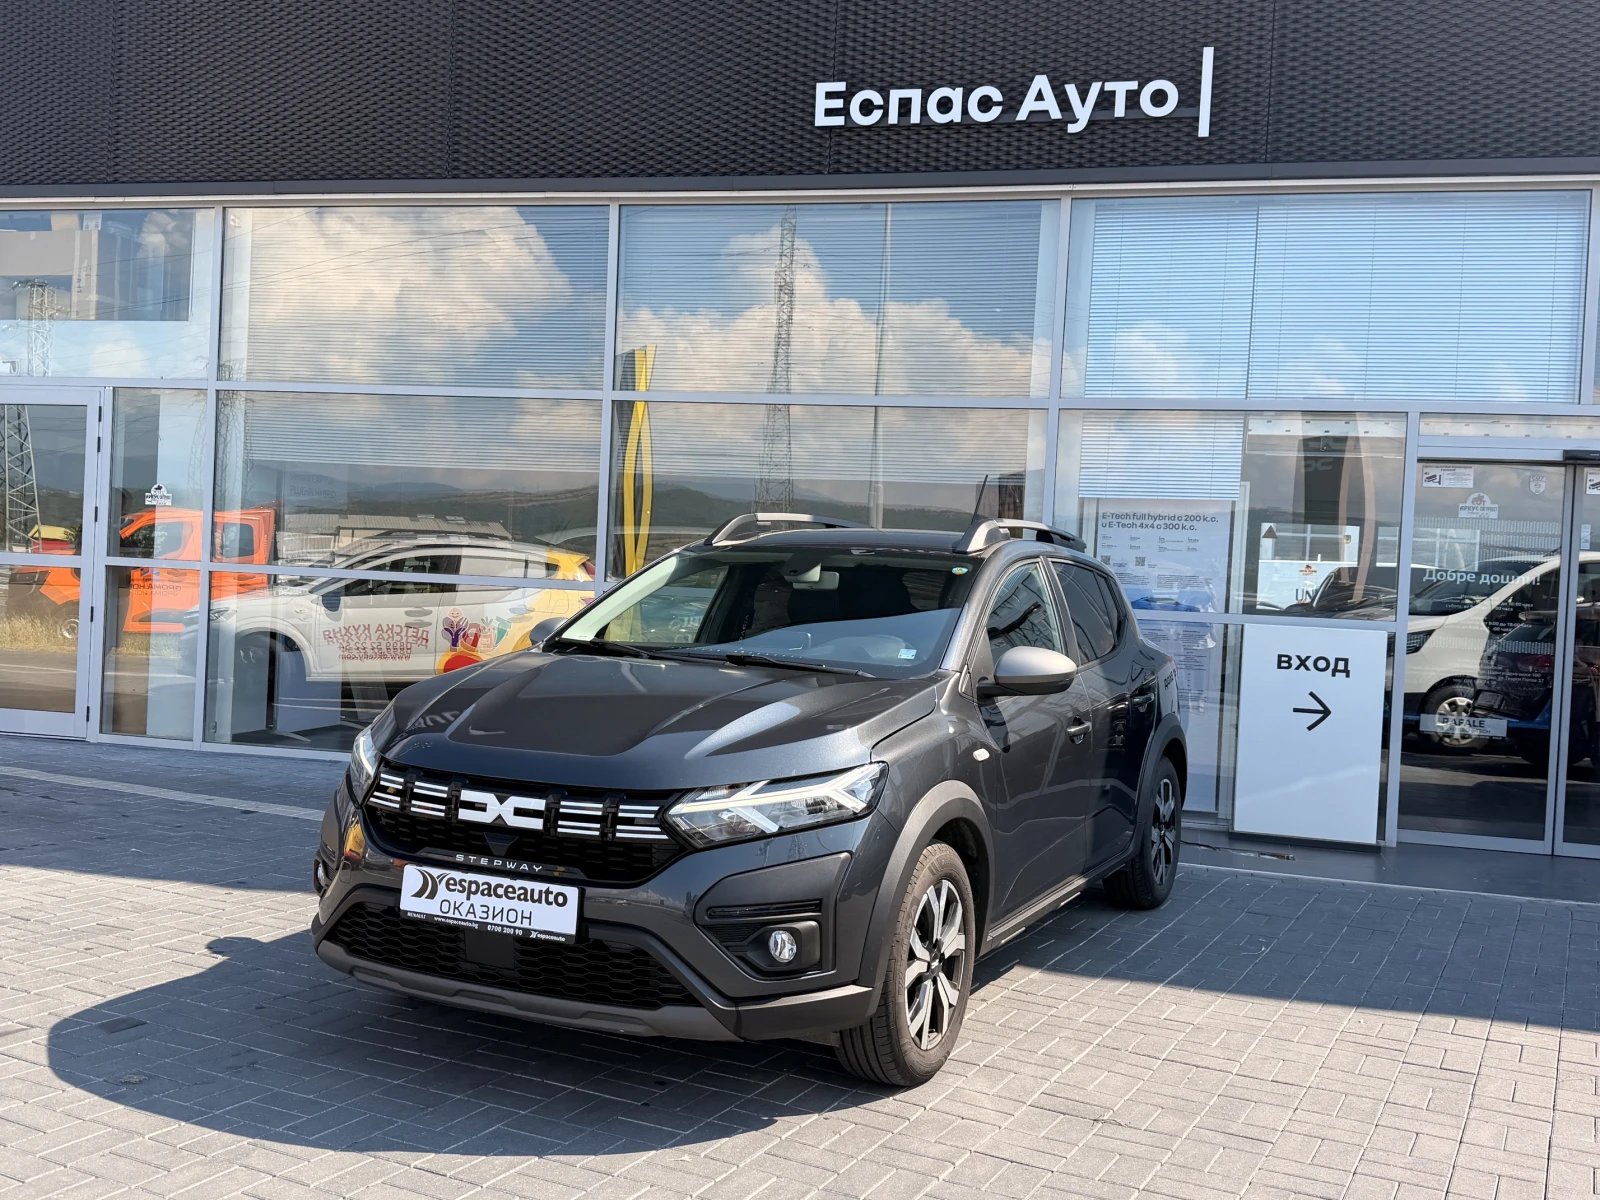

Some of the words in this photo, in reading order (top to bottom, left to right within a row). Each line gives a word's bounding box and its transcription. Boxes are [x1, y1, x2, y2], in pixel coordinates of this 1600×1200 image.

[813, 80, 1004, 128] Еспас
[1015, 73, 1180, 134] Ауто
[1102, 512, 1131, 521] E-Tech
[1132, 512, 1147, 521] full
[1147, 513, 1176, 524] hybrid
[1184, 514, 1201, 522] 200
[1108, 521, 1138, 529] E-Tech
[1162, 522, 1180, 531] 300
[1423, 568, 1476, 584] Добре
[1276, 653, 1351, 679] ВХОД
[1442, 717, 1486, 728] RAFALE
[455, 854, 543, 873] STEPWAY
[445, 872, 568, 908] espaceauto
[439, 899, 533, 927] ОКАЗИОН
[434, 915, 479, 930] www.espaceauto.bg
[487, 925, 502, 933] 0700
[502, 926, 514, 935] 200
[515, 928, 523, 936] 90
[537, 932, 566, 942] espaceauto
